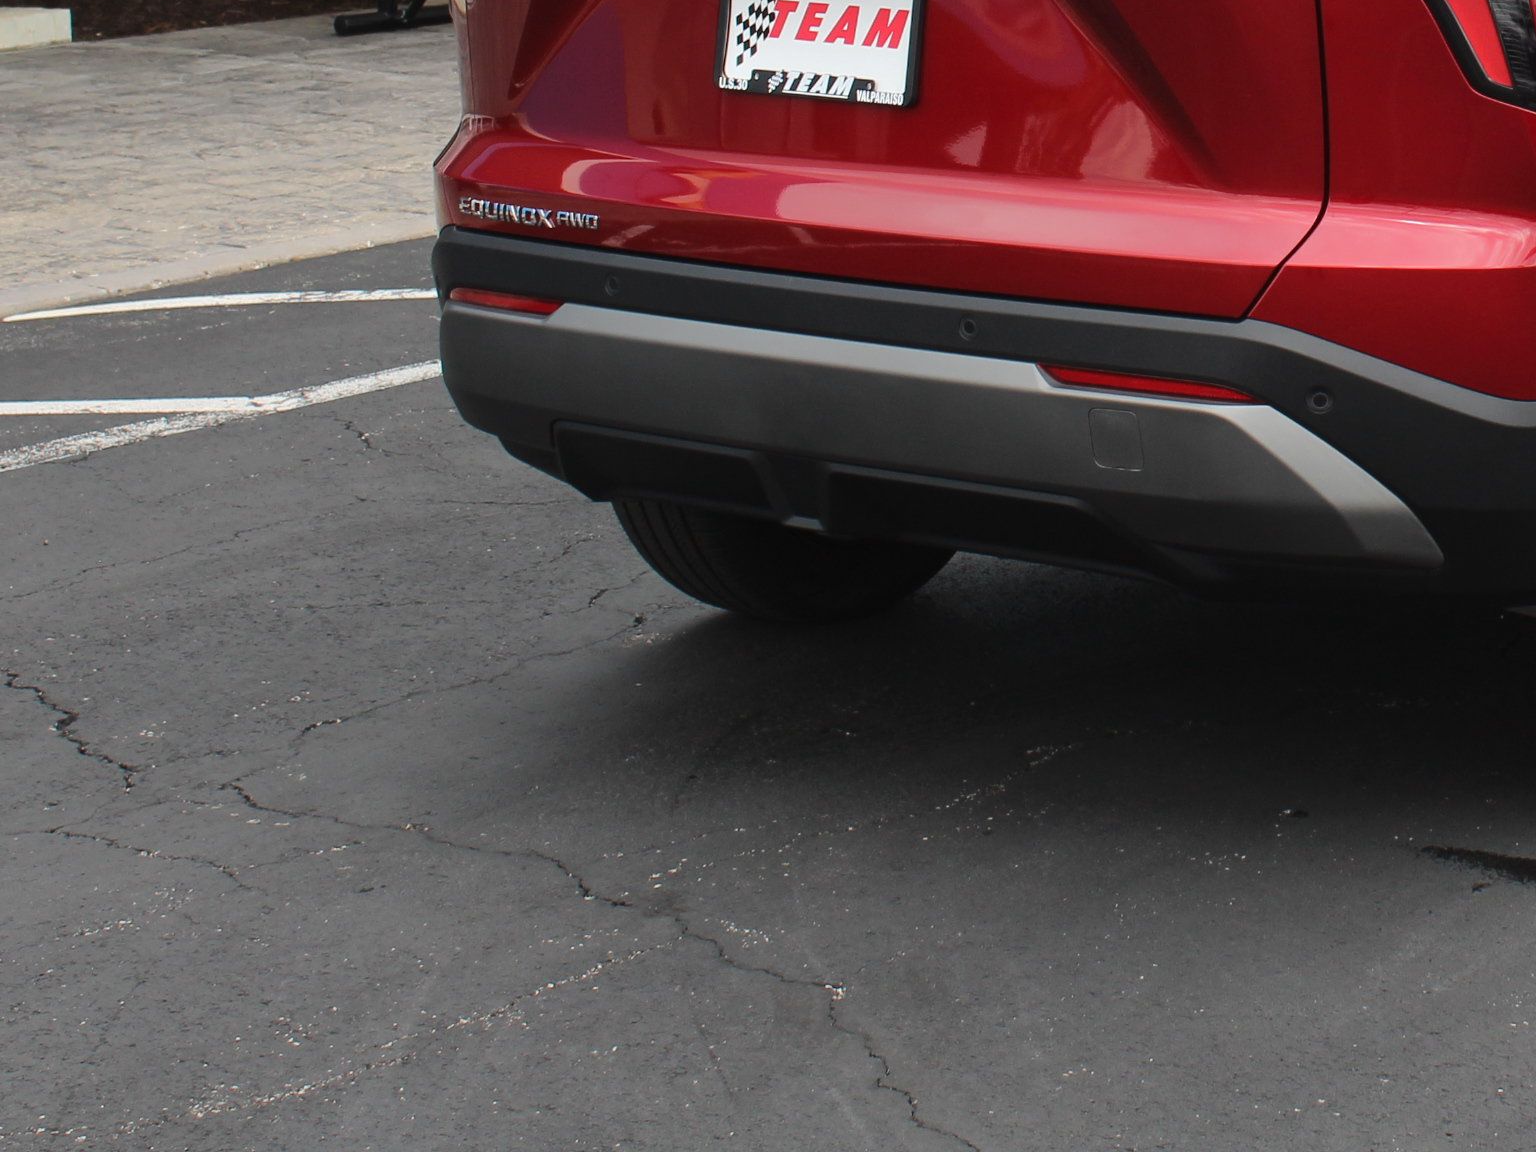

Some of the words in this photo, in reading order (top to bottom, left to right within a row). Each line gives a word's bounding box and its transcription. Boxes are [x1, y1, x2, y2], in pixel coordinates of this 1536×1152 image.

[769, 0, 909, 49] TEAM
[782, 70, 857, 97] TEAM
[856, 89, 904, 106] VALPARAISO
[458, 196, 555, 229] EQUINOX
[556, 210, 600, 230] AWD
